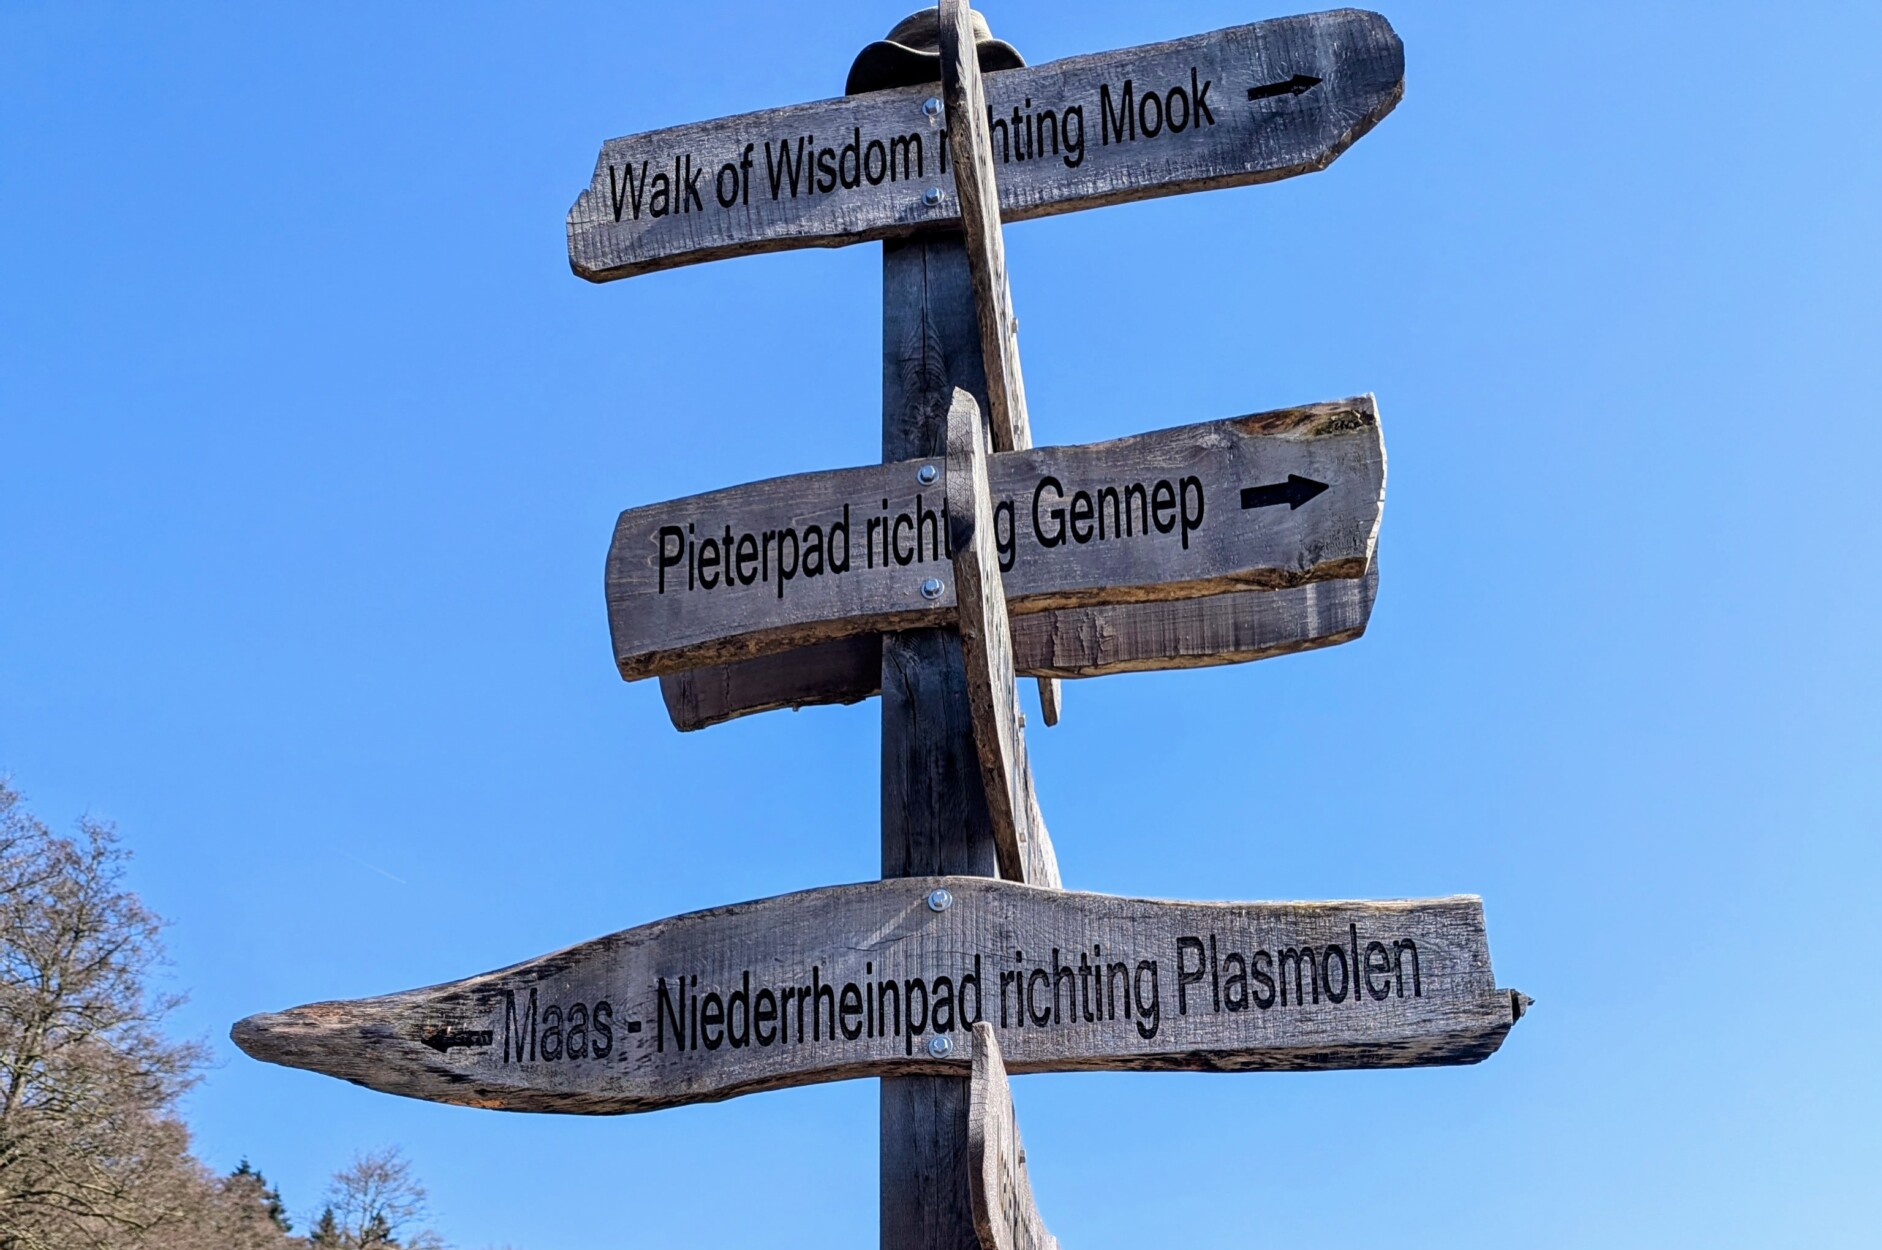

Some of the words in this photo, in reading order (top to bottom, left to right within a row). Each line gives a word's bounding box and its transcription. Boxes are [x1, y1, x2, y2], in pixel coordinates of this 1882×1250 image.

[609, 154, 704, 223] Walk
[716, 143, 754, 209] of
[764, 126, 924, 201] Wisdom
[939, 98, 1085, 174] rhting
[1100, 66, 1216, 147] Mook
[658, 503, 850, 600] Pieterpad
[866, 493, 1016, 573] richtg
[1032, 472, 1205, 550] Gennep
[503, 988, 614, 1064] Maas
[656, 953, 983, 1057] Niederrheinpad
[1000, 944, 1159, 1040] richting
[1176, 923, 1422, 1016] Plasmolen
